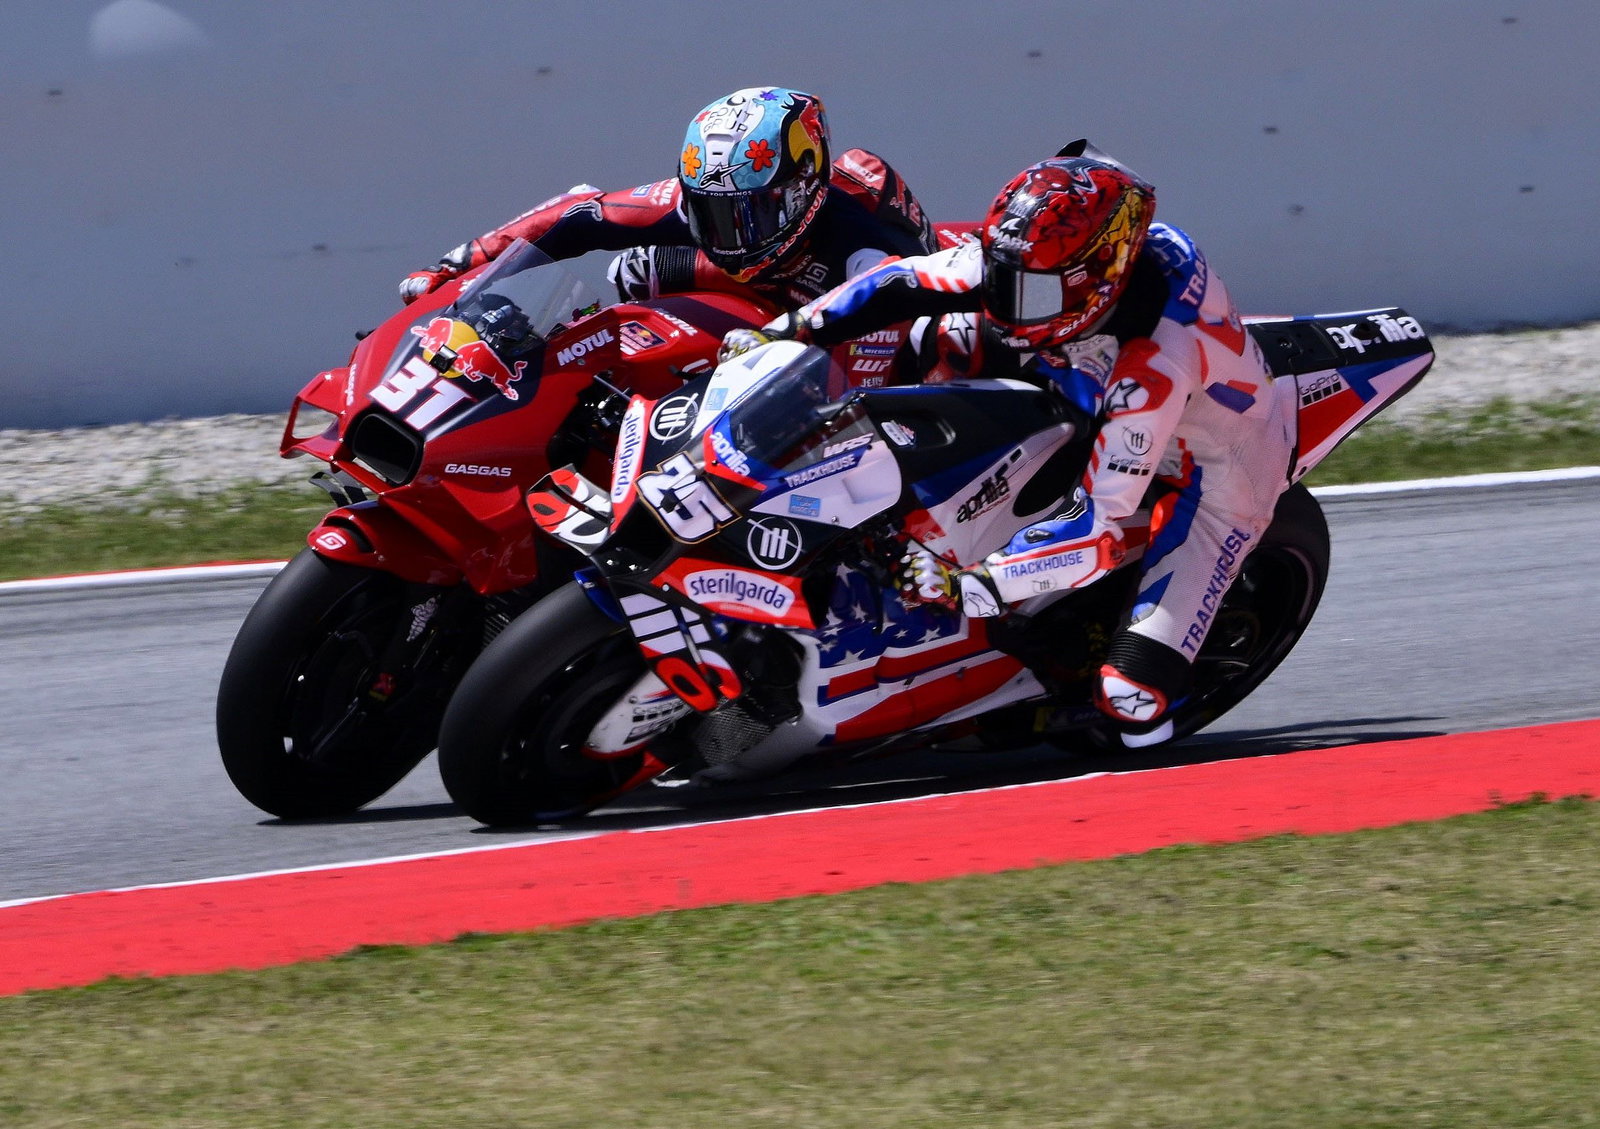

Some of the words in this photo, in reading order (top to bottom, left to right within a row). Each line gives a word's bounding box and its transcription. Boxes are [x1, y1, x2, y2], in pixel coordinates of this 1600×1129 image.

[556, 328, 615, 367] MOTUL
[368, 356, 472, 431] 31
[1300, 373, 1340, 396] GoPro
[444, 463, 512, 477] GASGAS
[784, 454, 857, 489] TRACKHOUSE
[636, 452, 735, 540] 25
[1003, 551, 1084, 579] TRACKHOUSE
[690, 572, 786, 609] sterilgarda
